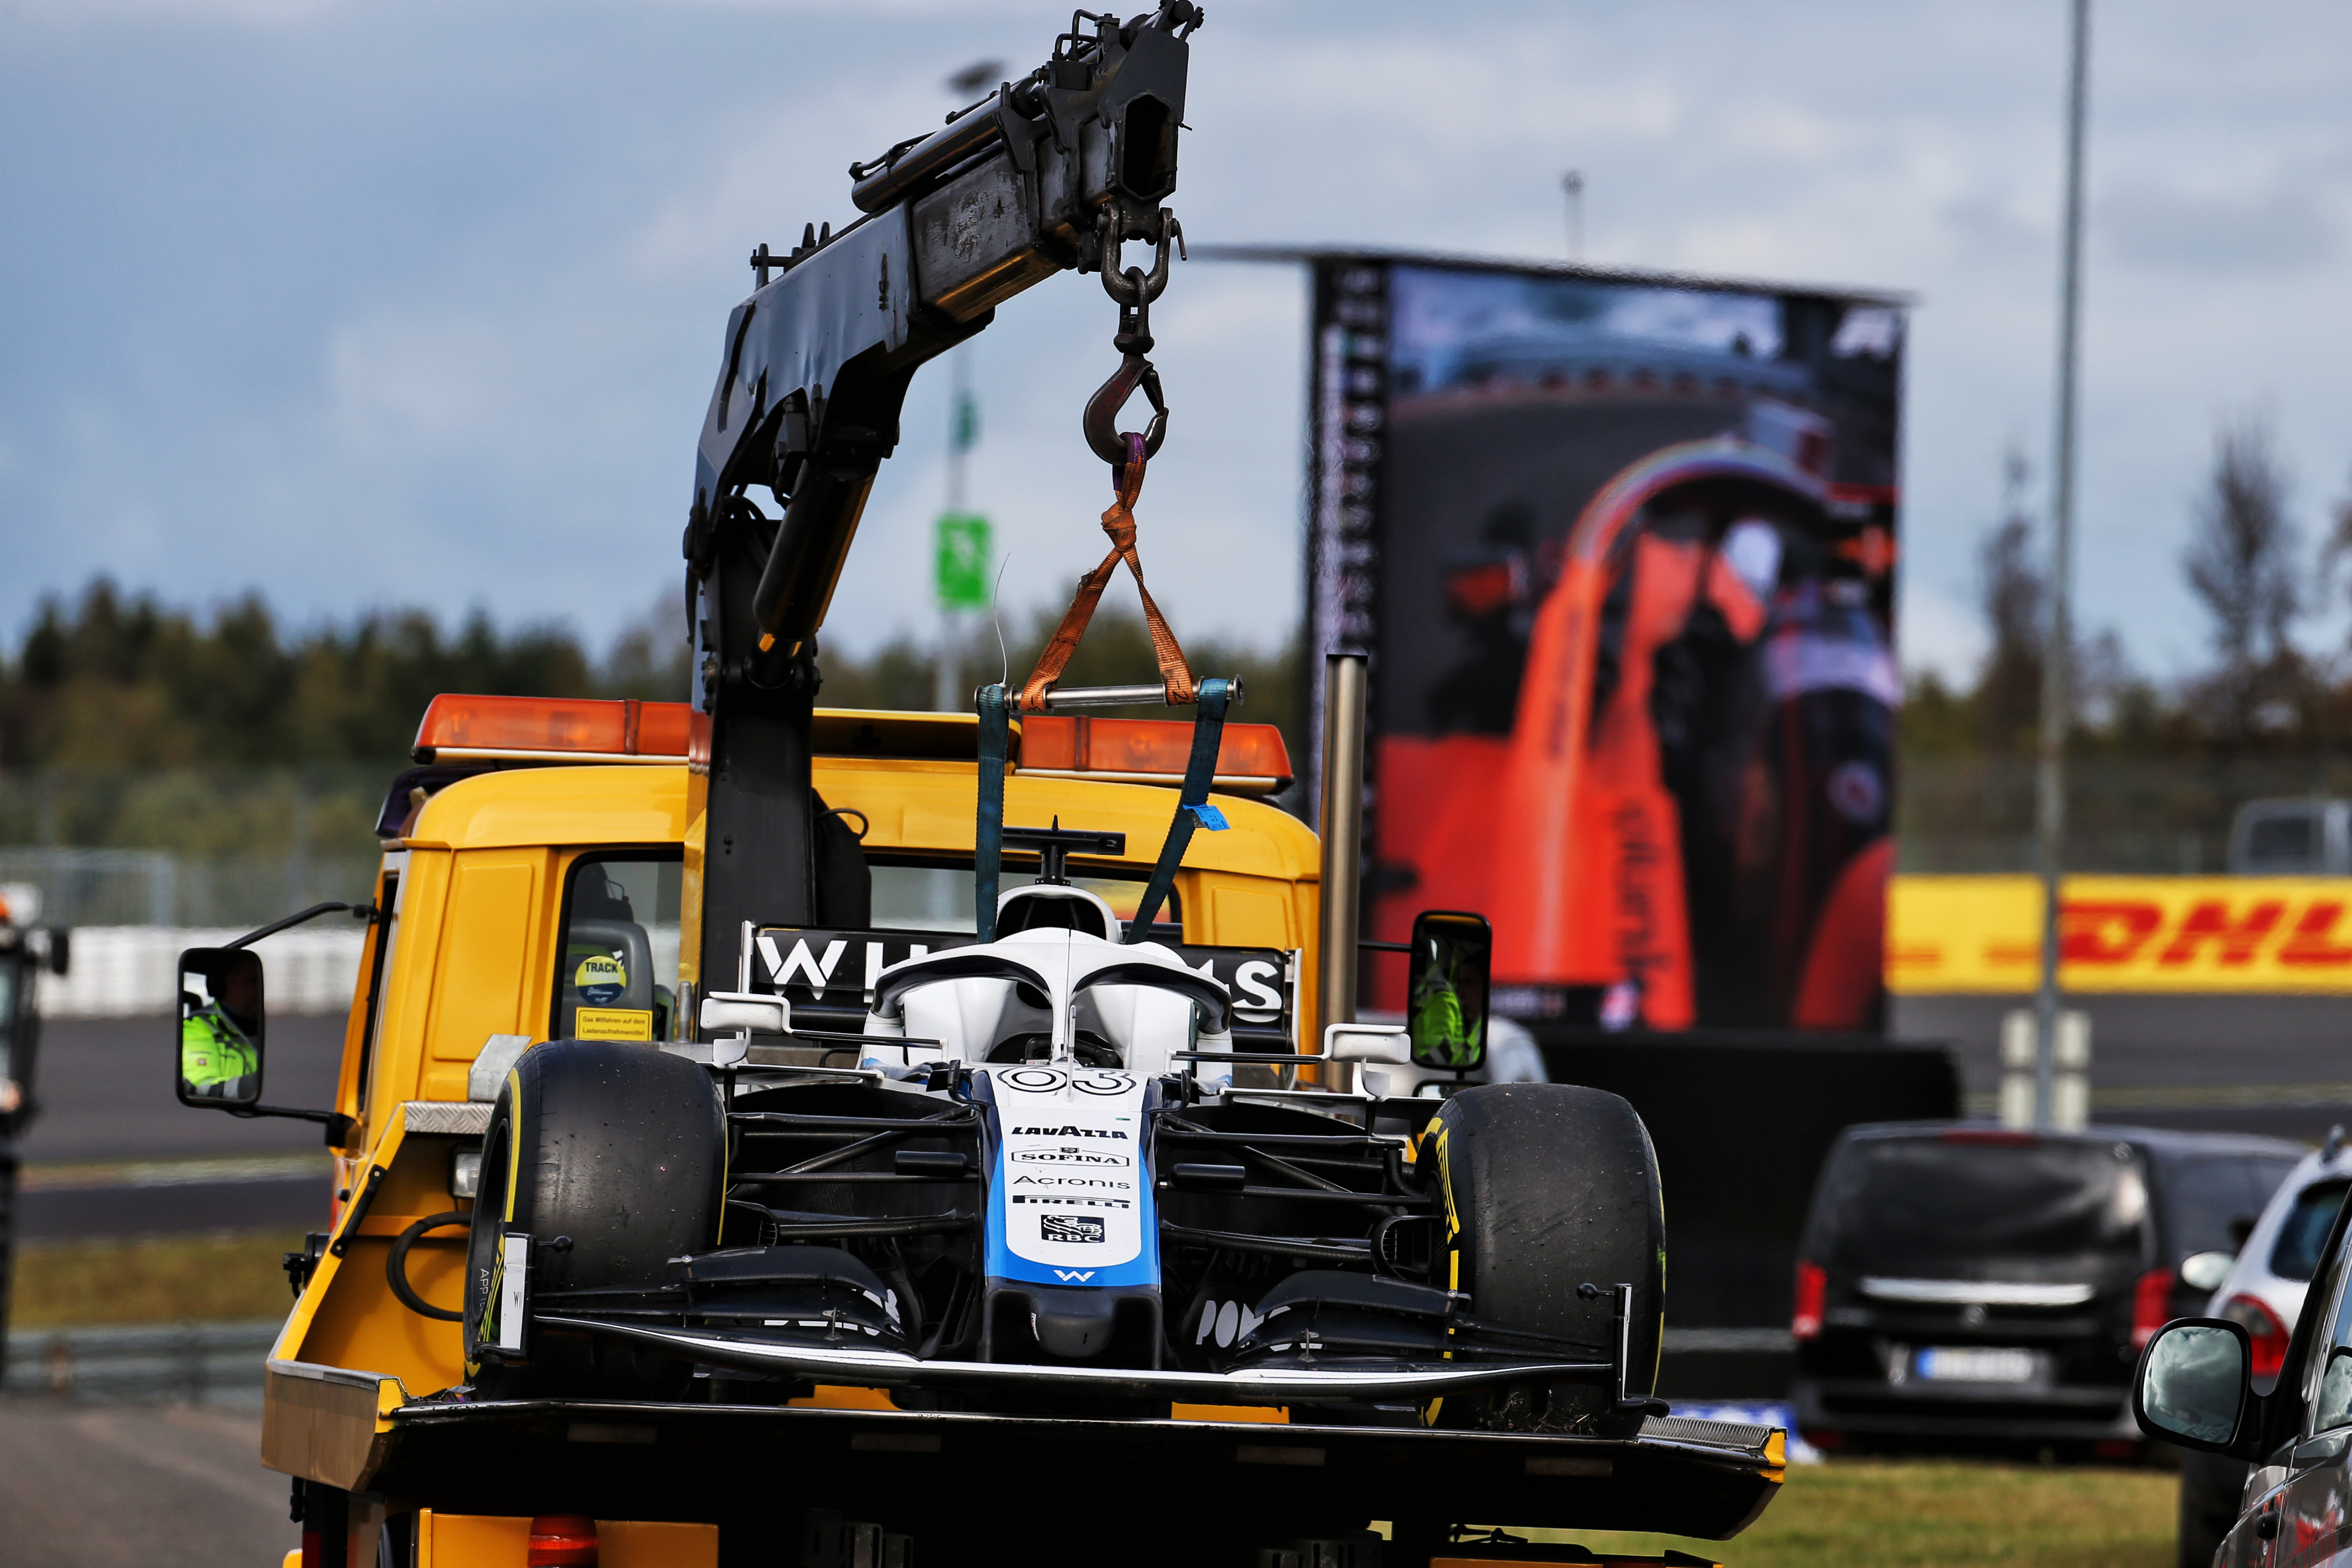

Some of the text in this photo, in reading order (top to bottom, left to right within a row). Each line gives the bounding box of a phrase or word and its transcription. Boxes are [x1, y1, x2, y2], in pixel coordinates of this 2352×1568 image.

[2060, 897, 2352, 969] DHL
[585, 962, 618, 973] TRACK
[1011, 1126, 1128, 1140] LAVAZZA
[1021, 1154, 1121, 1165] SOFINA
[1012, 1176, 1131, 1189] Acronis
[1012, 1195, 1131, 1209] PIRELLI
[1048, 1234, 1100, 1243] RBC
